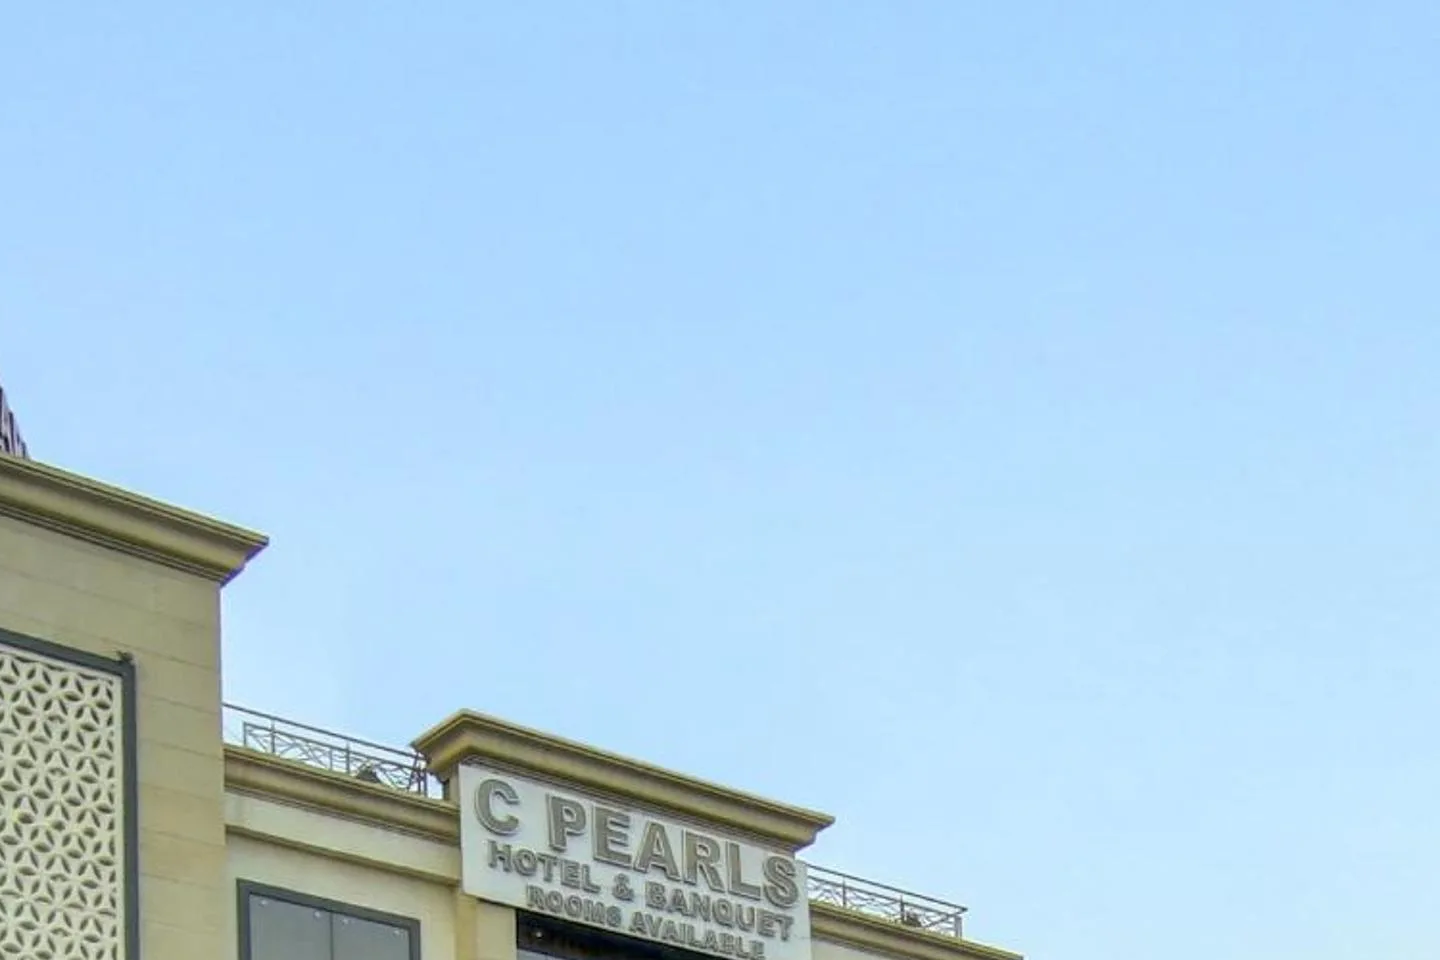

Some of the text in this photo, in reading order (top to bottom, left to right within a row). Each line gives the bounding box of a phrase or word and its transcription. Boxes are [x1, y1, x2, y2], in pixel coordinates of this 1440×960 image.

[476, 779, 797, 908] C PEARLS
[488, 839, 796, 942] HOTEL & BANQUET
[525, 883, 623, 929] ROOMS
